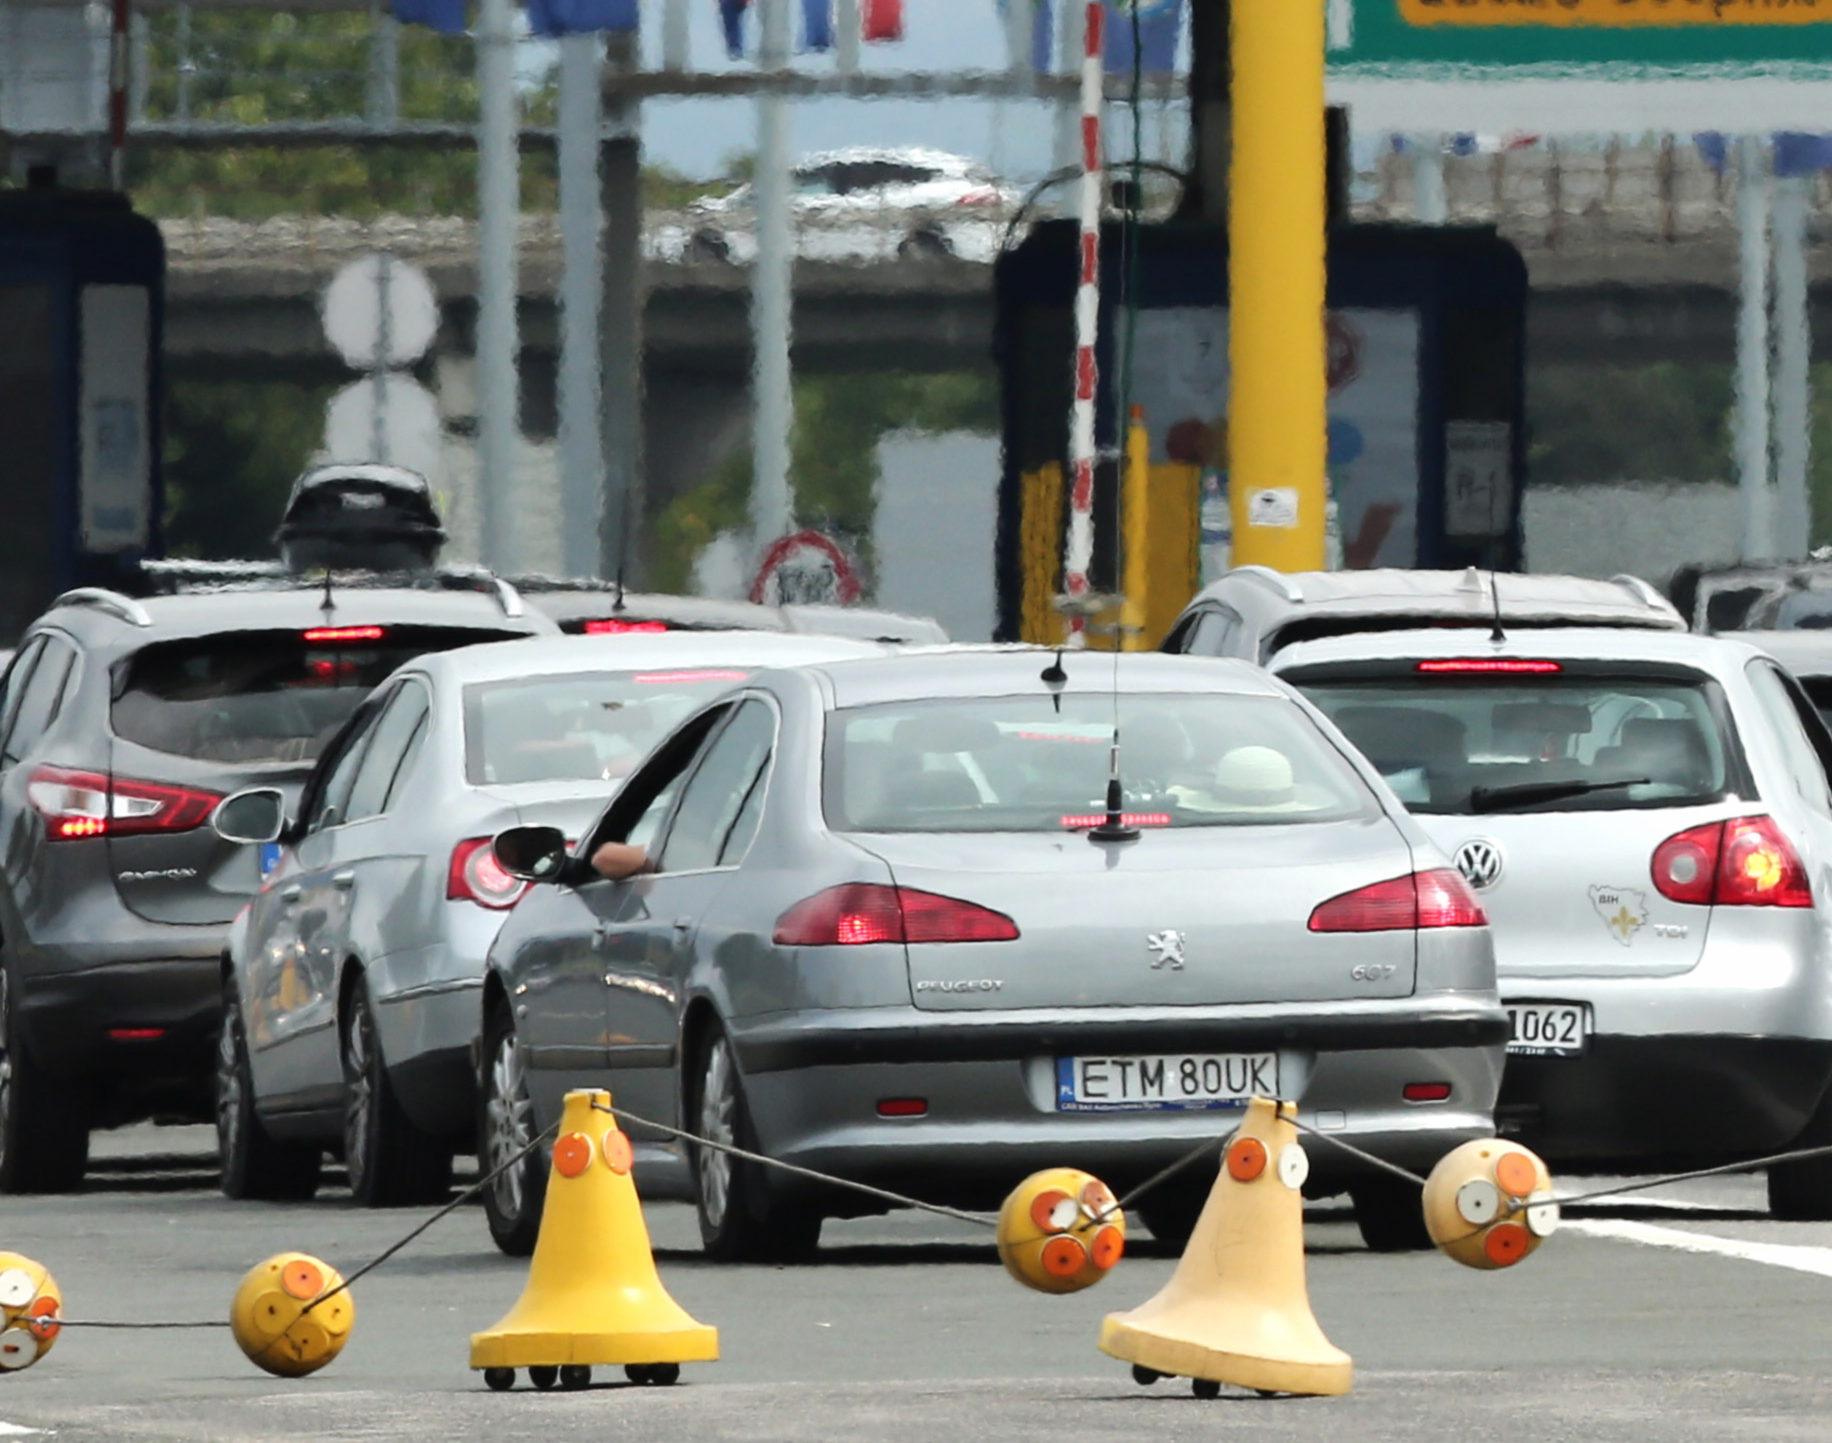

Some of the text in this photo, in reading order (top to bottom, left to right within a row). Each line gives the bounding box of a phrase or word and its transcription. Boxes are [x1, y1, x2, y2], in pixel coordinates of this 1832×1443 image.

[1351, 963, 1397, 982] 607
[917, 979, 1004, 993] PEUGEOT
[1082, 1056, 1272, 1099] ETM 80UK
